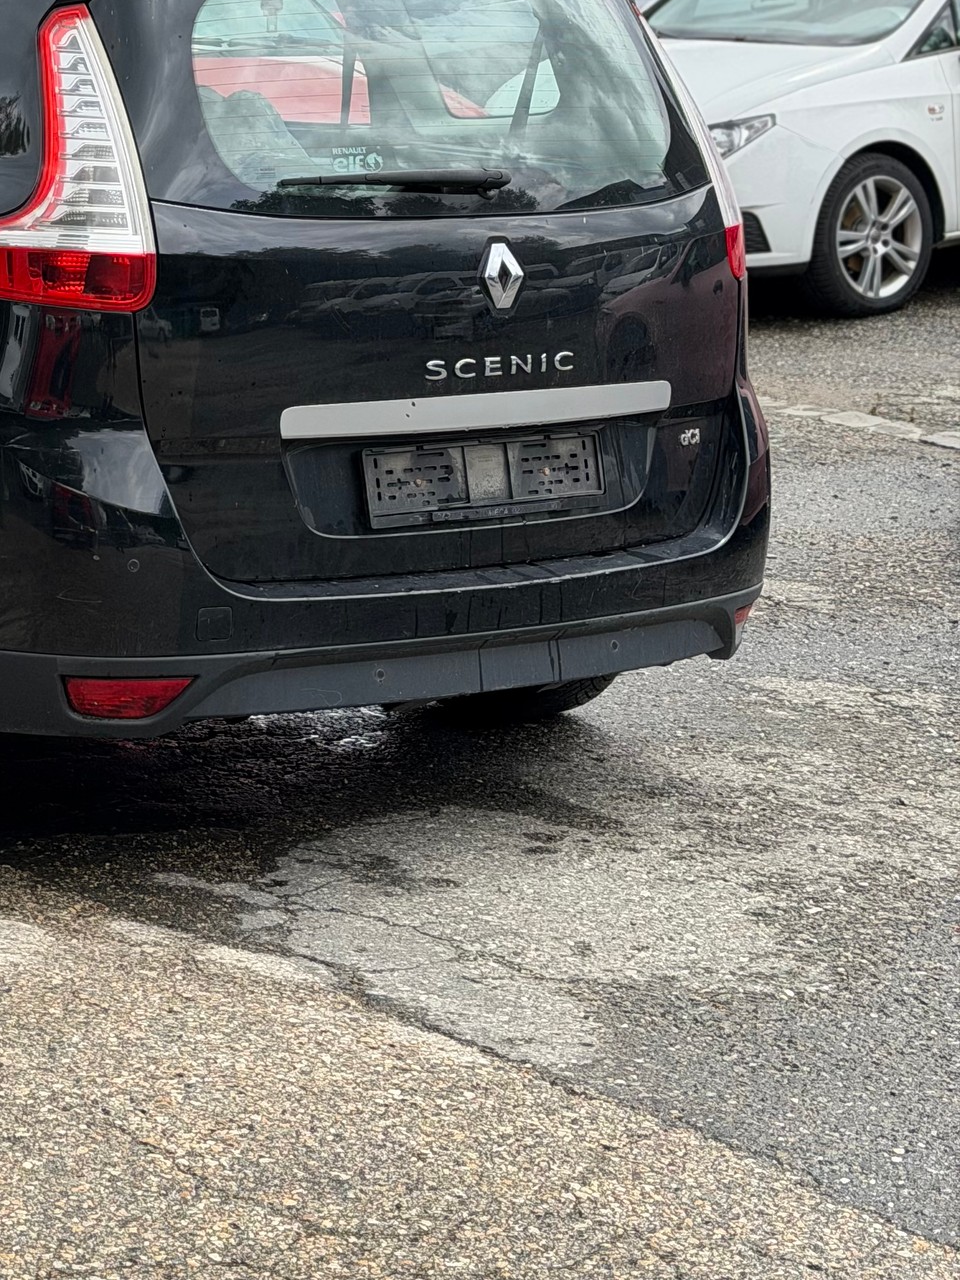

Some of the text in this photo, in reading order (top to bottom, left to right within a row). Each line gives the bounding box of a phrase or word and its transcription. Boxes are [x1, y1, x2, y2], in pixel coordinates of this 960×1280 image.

[332, 146, 366, 155] RENAULT
[333, 155, 365, 173] elf
[424, 351, 575, 381] SCENIC
